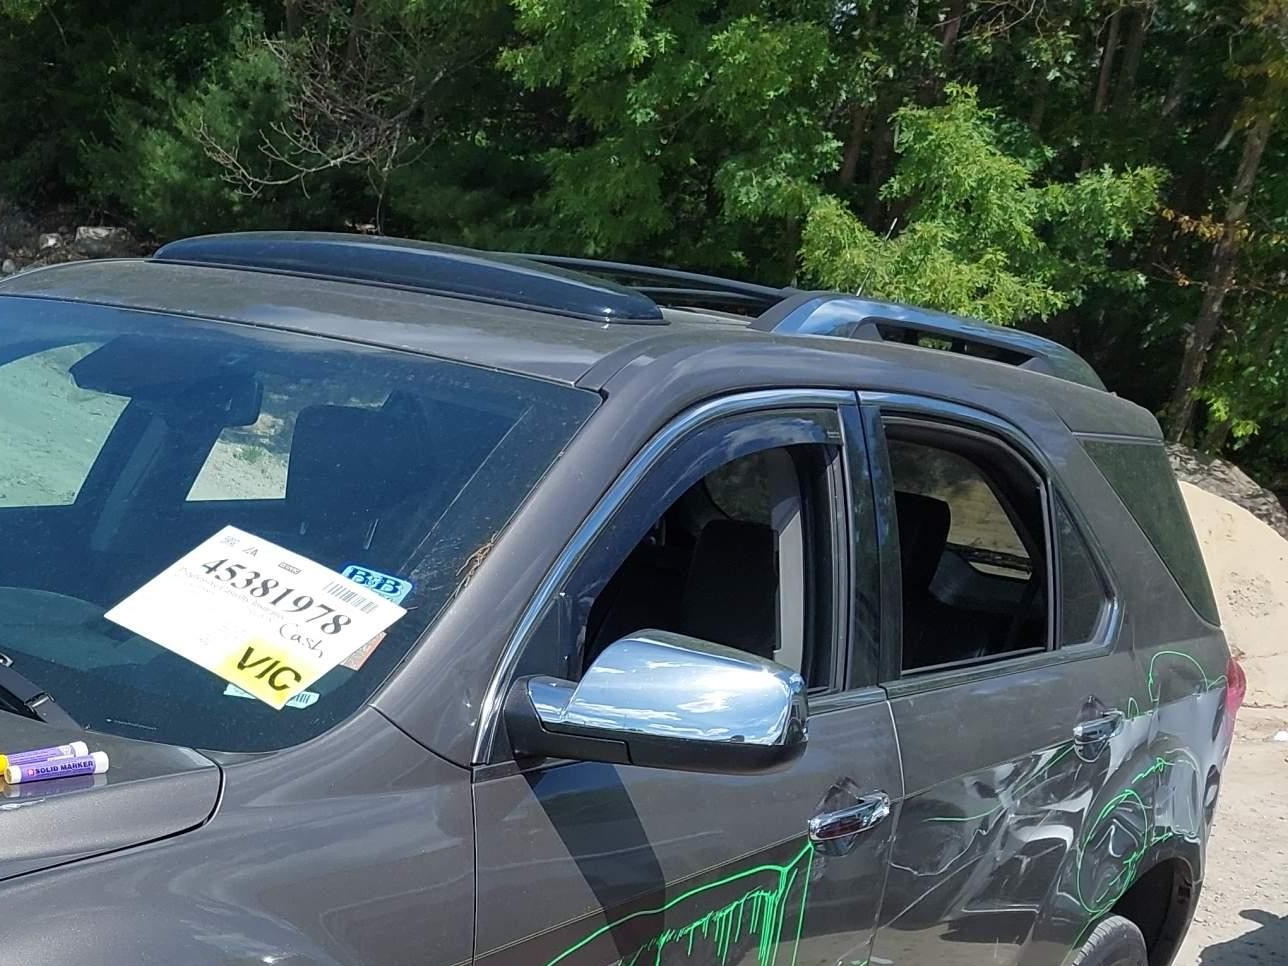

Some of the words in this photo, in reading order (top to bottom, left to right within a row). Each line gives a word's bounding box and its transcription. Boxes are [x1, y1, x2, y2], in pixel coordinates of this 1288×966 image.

[200, 558, 352, 636] 45381978
[237, 646, 302, 691] VIC
[34, 766, 59, 775] SOLID
[60, 760, 94, 771] MARKER
